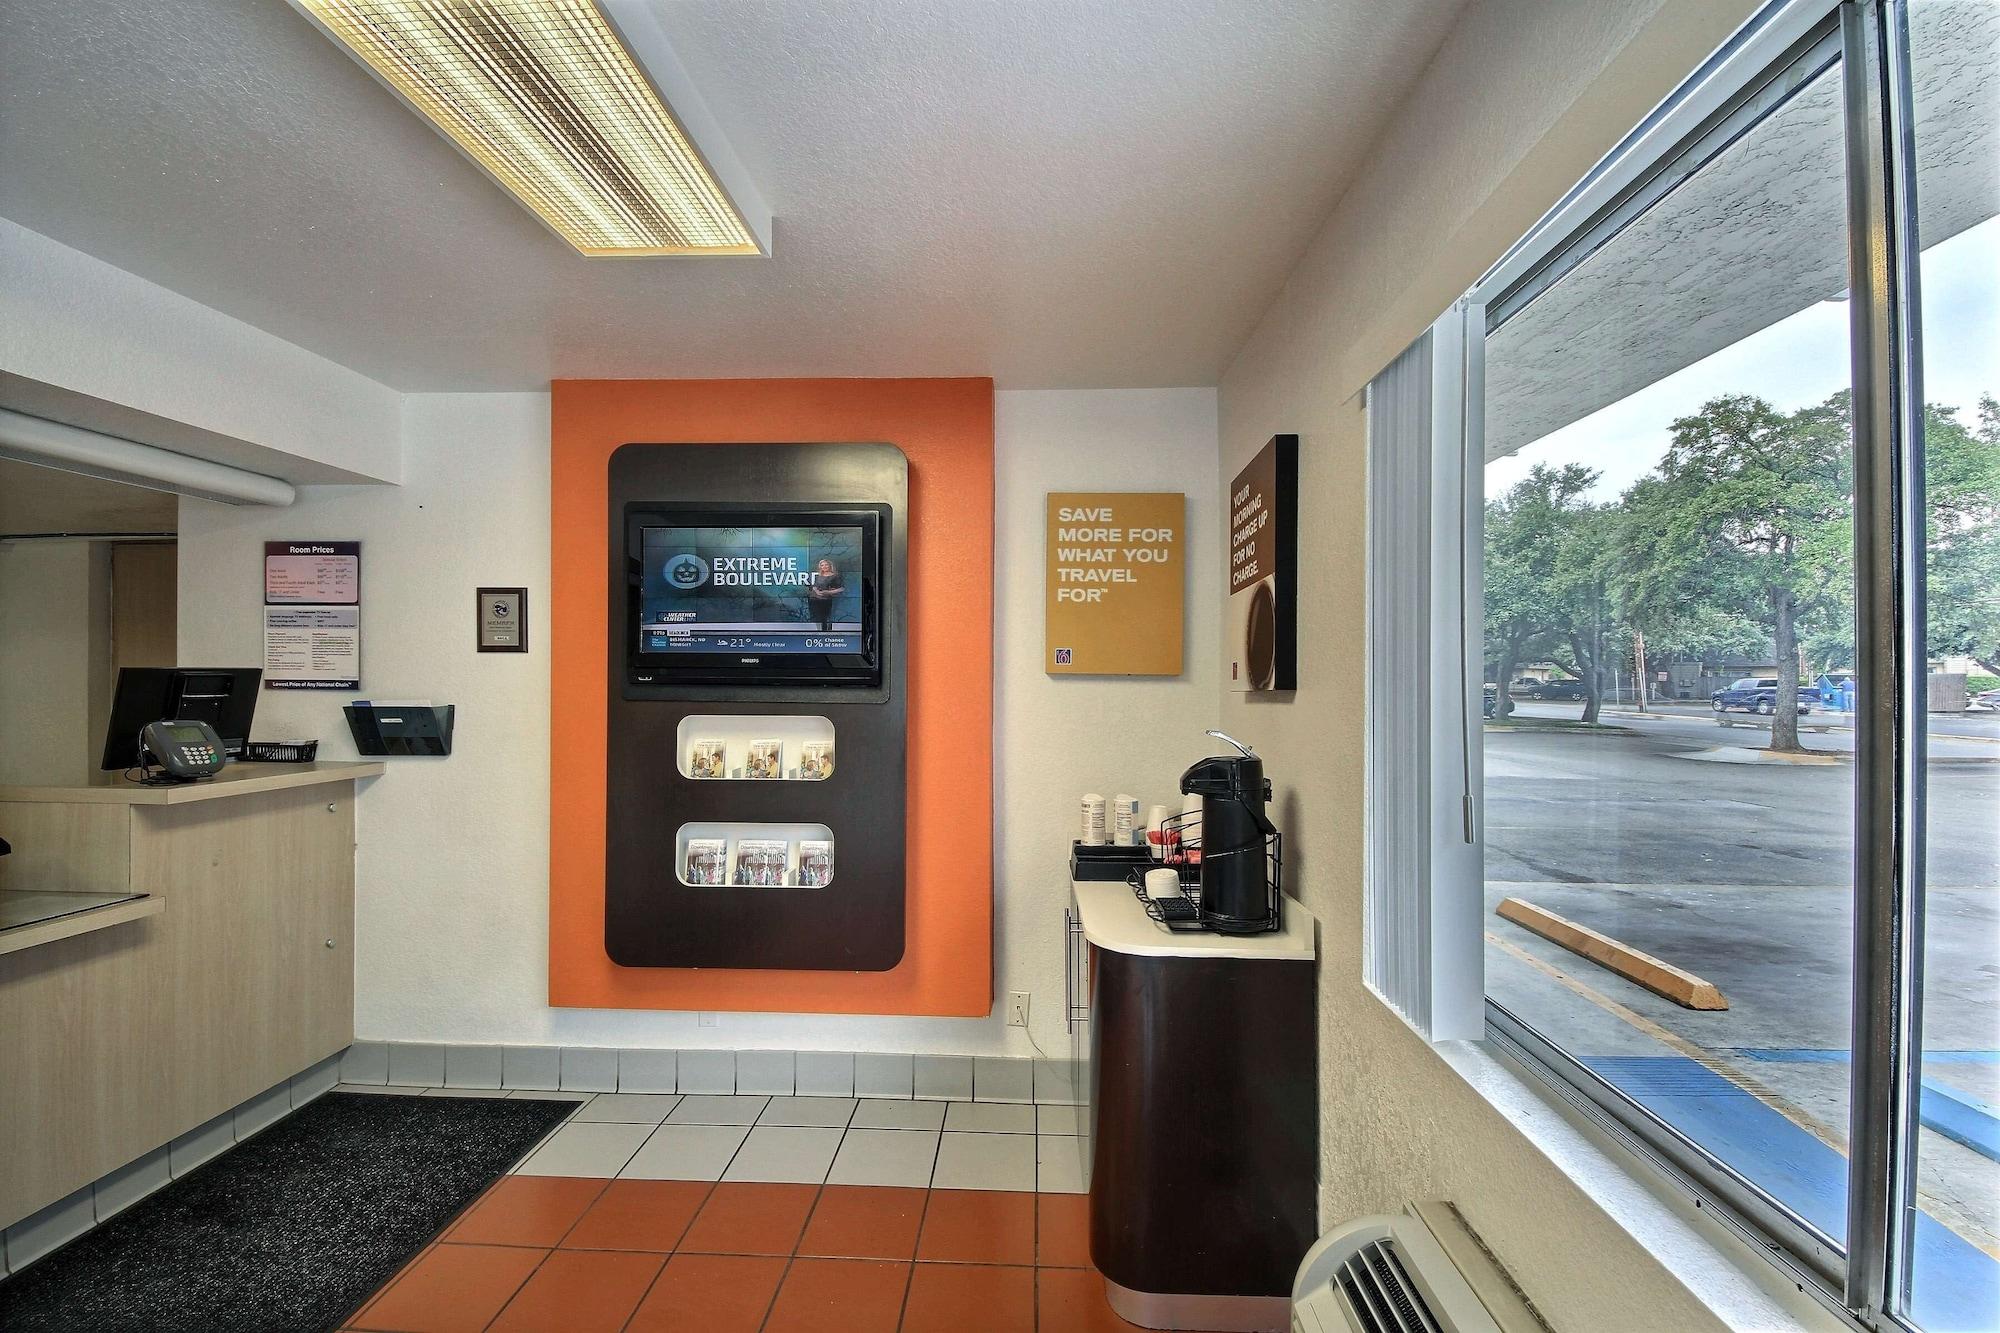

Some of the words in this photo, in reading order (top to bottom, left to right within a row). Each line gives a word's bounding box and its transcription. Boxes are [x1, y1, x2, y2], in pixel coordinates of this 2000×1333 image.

[1234, 484, 1250, 508] YOUR
[1058, 507, 1113, 522] SAVE
[1233, 493, 1262, 529] MORNING
[1058, 528, 1122, 542] MORE
[1128, 528, 1173, 542] FOR
[1233, 518, 1258, 547] CHARGE
[1258, 509, 1268, 529] UP
[1057, 548, 1116, 562] WHAT
[1123, 548, 1168, 562] YOU
[1233, 547, 1246, 567] FOR
[1245, 541, 1256, 559] NO
[713, 557, 797, 571] EXTREME
[1057, 568, 1137, 582] TRAVEL
[805, 638, 823, 648] 0%
